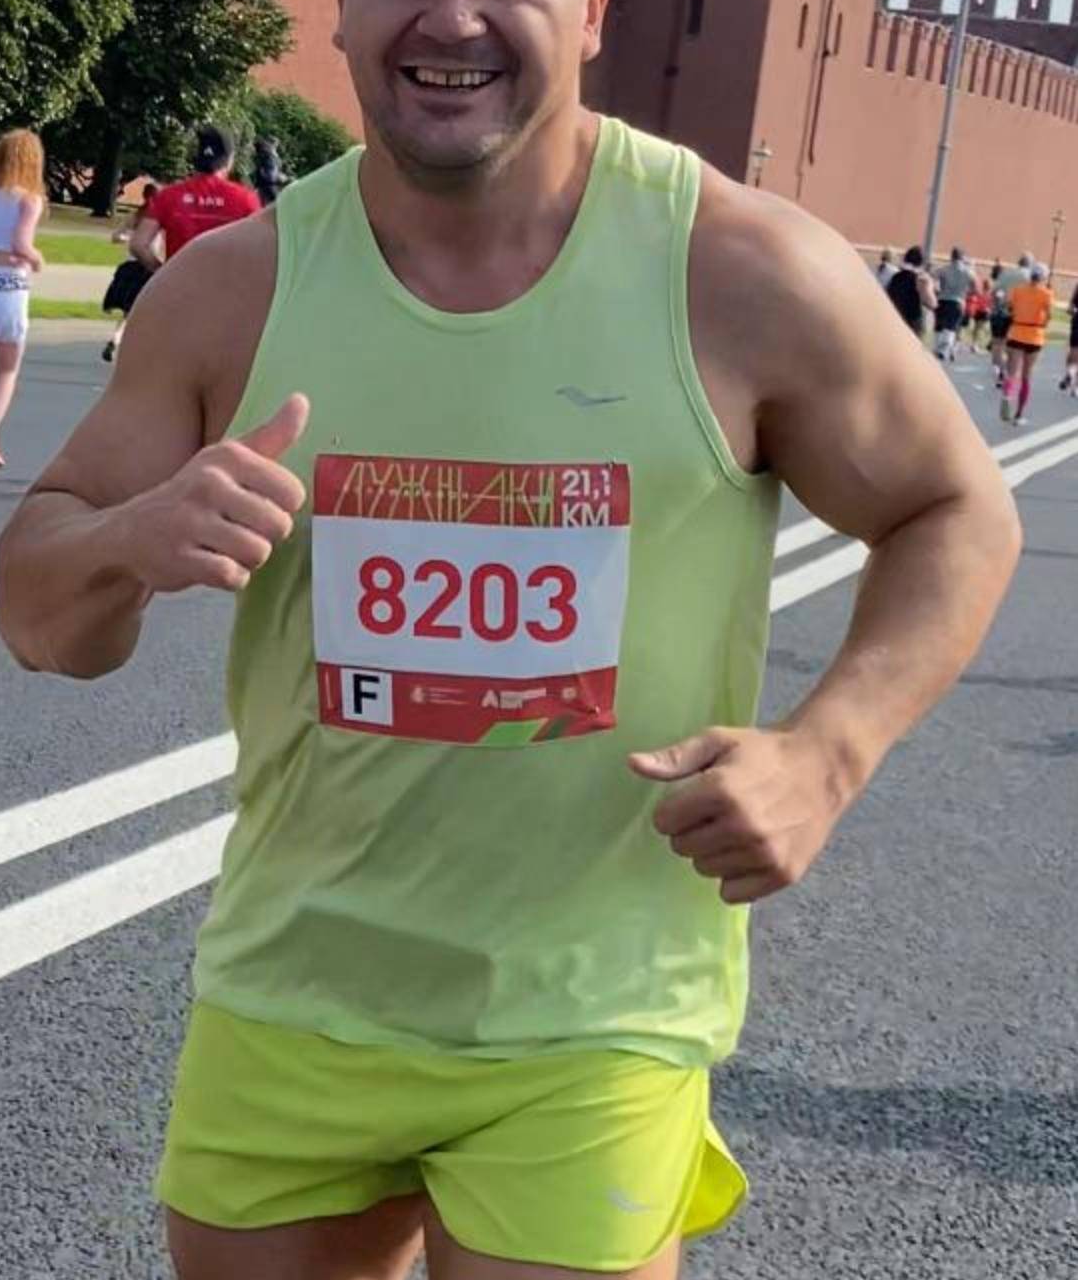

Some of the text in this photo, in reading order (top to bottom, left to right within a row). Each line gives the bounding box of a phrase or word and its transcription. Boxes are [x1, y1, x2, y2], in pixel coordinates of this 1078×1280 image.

[561, 469, 612, 501] 21,1
[357, 555, 579, 643] 8203
[352, 672, 381, 715] F
